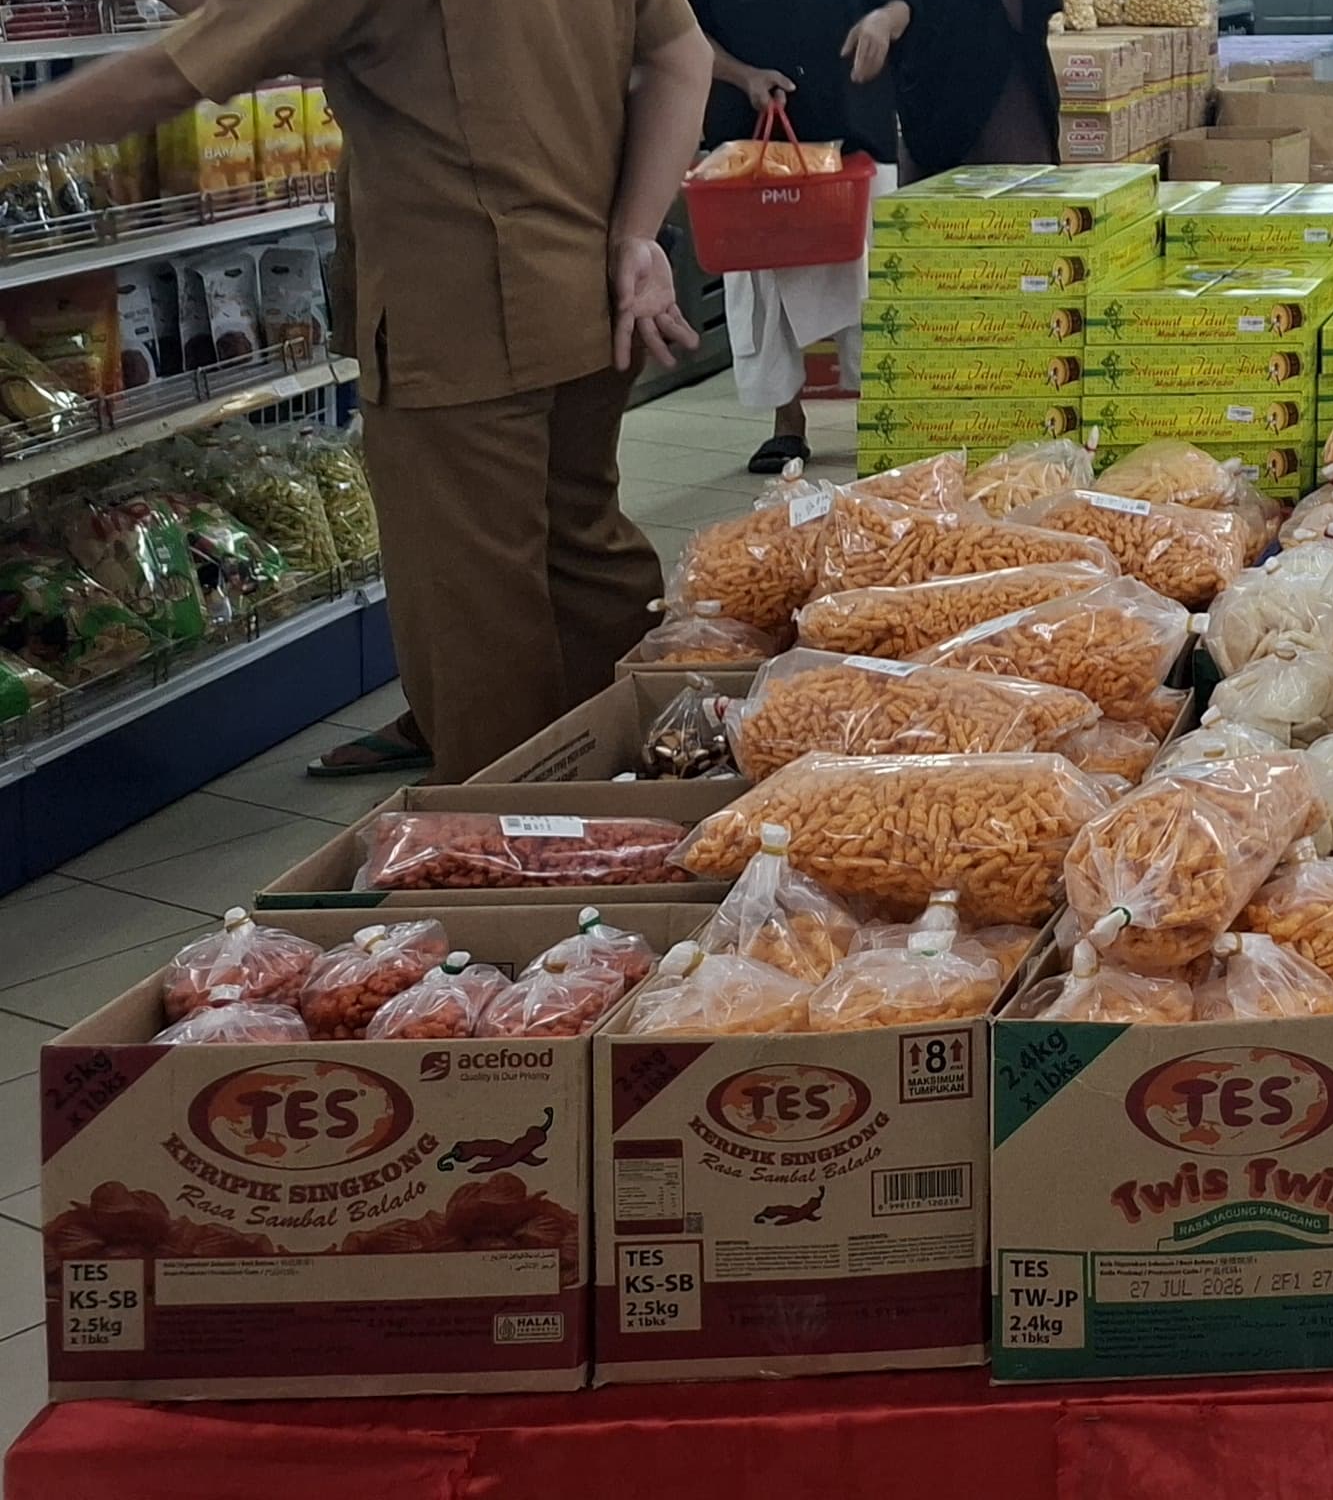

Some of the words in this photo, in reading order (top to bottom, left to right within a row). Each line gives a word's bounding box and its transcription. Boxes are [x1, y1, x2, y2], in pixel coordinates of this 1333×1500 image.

[762, 188, 801, 204] PMU
[457, 1048, 554, 1069] acefood
[925, 1040, 947, 1074] 8
[908, 1084, 965, 1097] TUMPUKAN
[742, 1083, 832, 1121] TES
[1172, 1076, 1294, 1128] TES
[236, 1089, 360, 1141] TES
[689, 1115, 776, 1166] KERIPIK
[780, 1111, 890, 1167] SINGKONG
[160, 1132, 281, 1204] KERIPIK
[289, 1131, 440, 1204] SINGKONG
[1110, 1161, 1229, 1223] Twis
[174, 1183, 237, 1220] Rasa
[245, 1205, 338, 1229] Sambal
[347, 1180, 428, 1222] Balado
[626, 1251, 664, 1267] TES
[1010, 1259, 1049, 1278] TES
[70, 1263, 108, 1282] TES
[625, 1275, 695, 1295] KS-SB
[1130, 1280, 1152, 1298] 27
[1160, 1278, 1194, 1297] JUL
[1202, 1277, 1244, 1296] 2026
[70, 1291, 138, 1310] KS-SB
[1010, 1288, 1078, 1308] TW-JP
[626, 1301, 679, 1318] 2.5kg
[70, 1317, 123, 1336] 2.5kg
[517, 1315, 558, 1327] HALAL
[638, 1316, 666, 1327] 1bks
[1010, 1315, 1063, 1337] 2.4kg
[1022, 1332, 1050, 1344] 1bks
